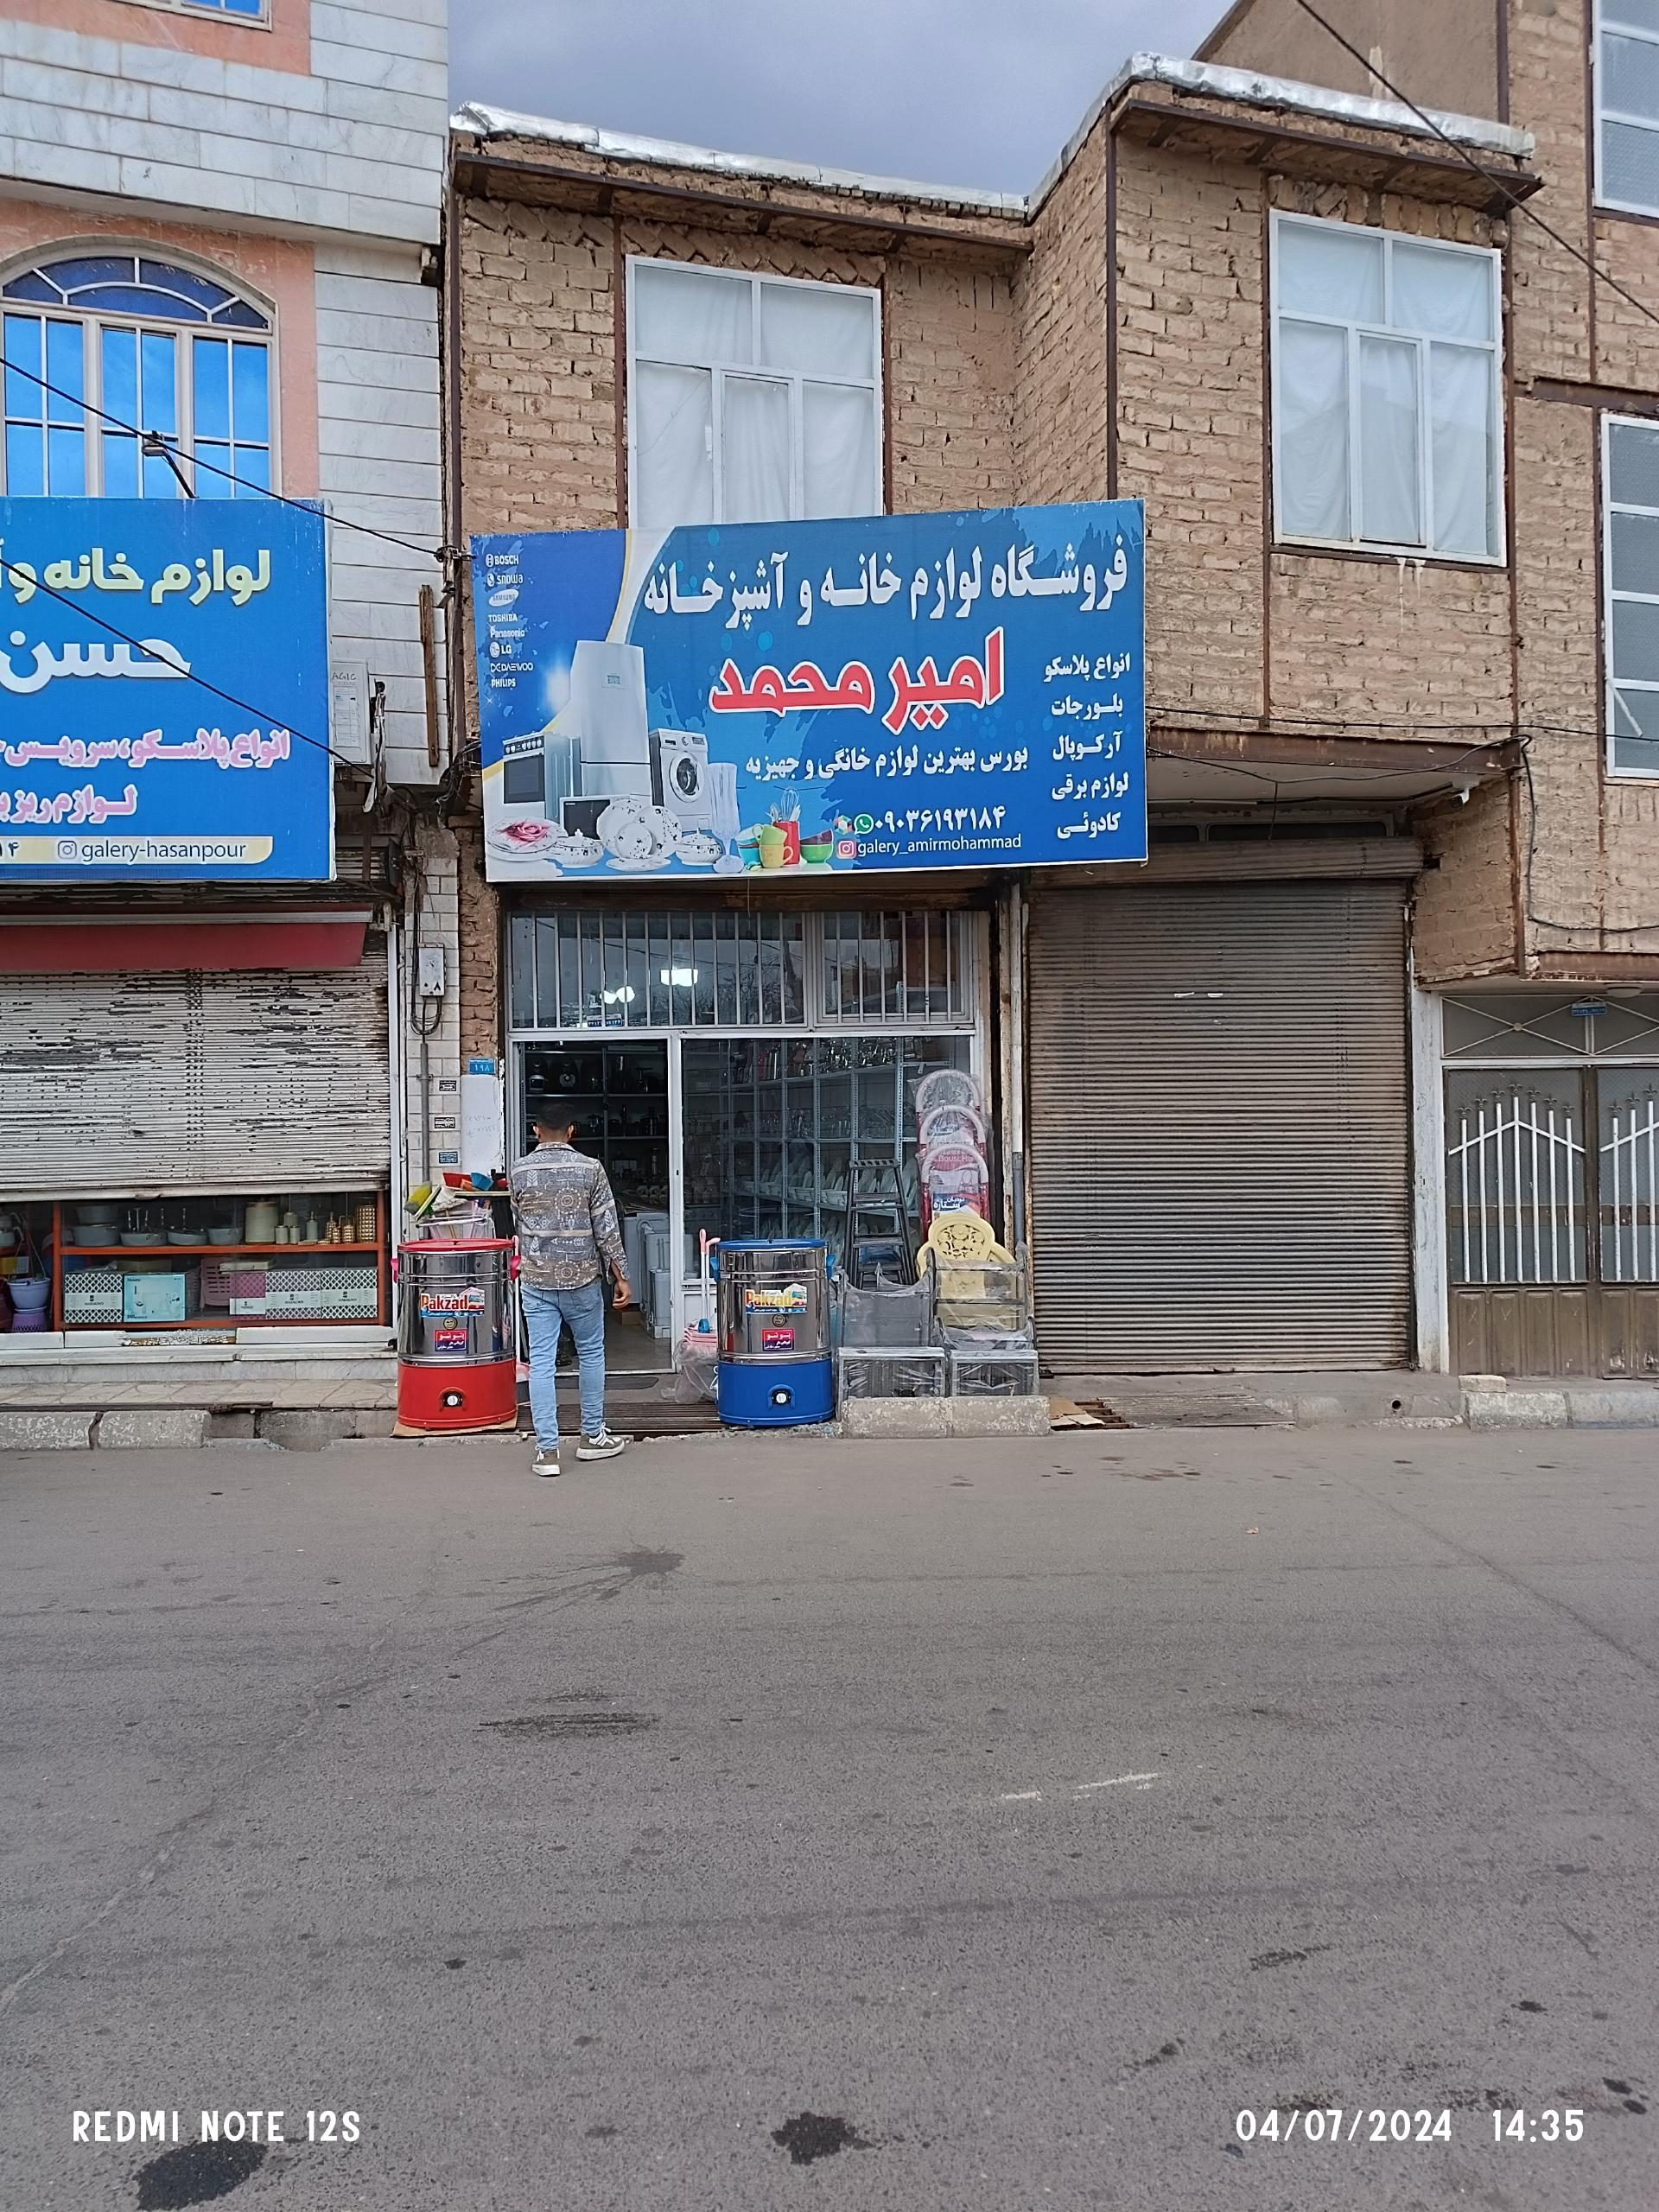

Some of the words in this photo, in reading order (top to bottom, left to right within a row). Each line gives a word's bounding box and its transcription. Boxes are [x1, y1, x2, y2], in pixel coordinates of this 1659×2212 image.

[43, 546, 145, 590] خانه
[494, 555, 519, 565] BOSCH
[991, 534, 1128, 612] فروشگاه
[8, 562, 37, 604] و
[150, 548, 271, 606] لوازم
[644, 551, 789, 632] آشپزخانه
[820, 551, 902, 607] خانه
[910, 545, 982, 620] لوازم
[797, 579, 812, 626] و
[488, 613, 518, 623] TOSHIBA
[490, 628, 525, 639] Panasonic
[0, 630, 192, 694] حسن
[501, 645, 512, 654] LG
[501, 663, 534, 672] DAEWOO
[880, 625, 1005, 736] امیر
[1043, 654, 1090, 683] پلاسکو
[1093, 652, 1131, 680] انواع
[491, 678, 517, 689] PHILIPS
[708, 658, 875, 718] محمد
[1051, 693, 1124, 721] بلورجات
[4, 734, 119, 768] سرویس
[230, 728, 291, 769] انواع
[922, 746, 976, 774] بهترین
[980, 746, 1029, 773] بورس
[1052, 730, 1123, 761] آرکوپال
[745, 754, 800, 781] جهیزیه
[804, 758, 815, 778] و
[818, 747, 872, 779] خانگی
[875, 744, 918, 777] لوازم
[1051, 772, 1089, 800] برقی
[1091, 771, 1129, 799] لوازم
[10, 788, 52, 824] ریز
[52, 783, 138, 824] لوازم
[874, 804, 1007, 834] ۰۹۰۳۶۱۹۳۱۸۴
[1056, 811, 1122, 840] کادوئی
[81, 839, 247, 859] galery-hasanpour
[857, 833, 1022, 858] galery_amirmohammad
[421, 1294, 467, 1310] Pakzad
[746, 1291, 791, 1306] Pakzad
